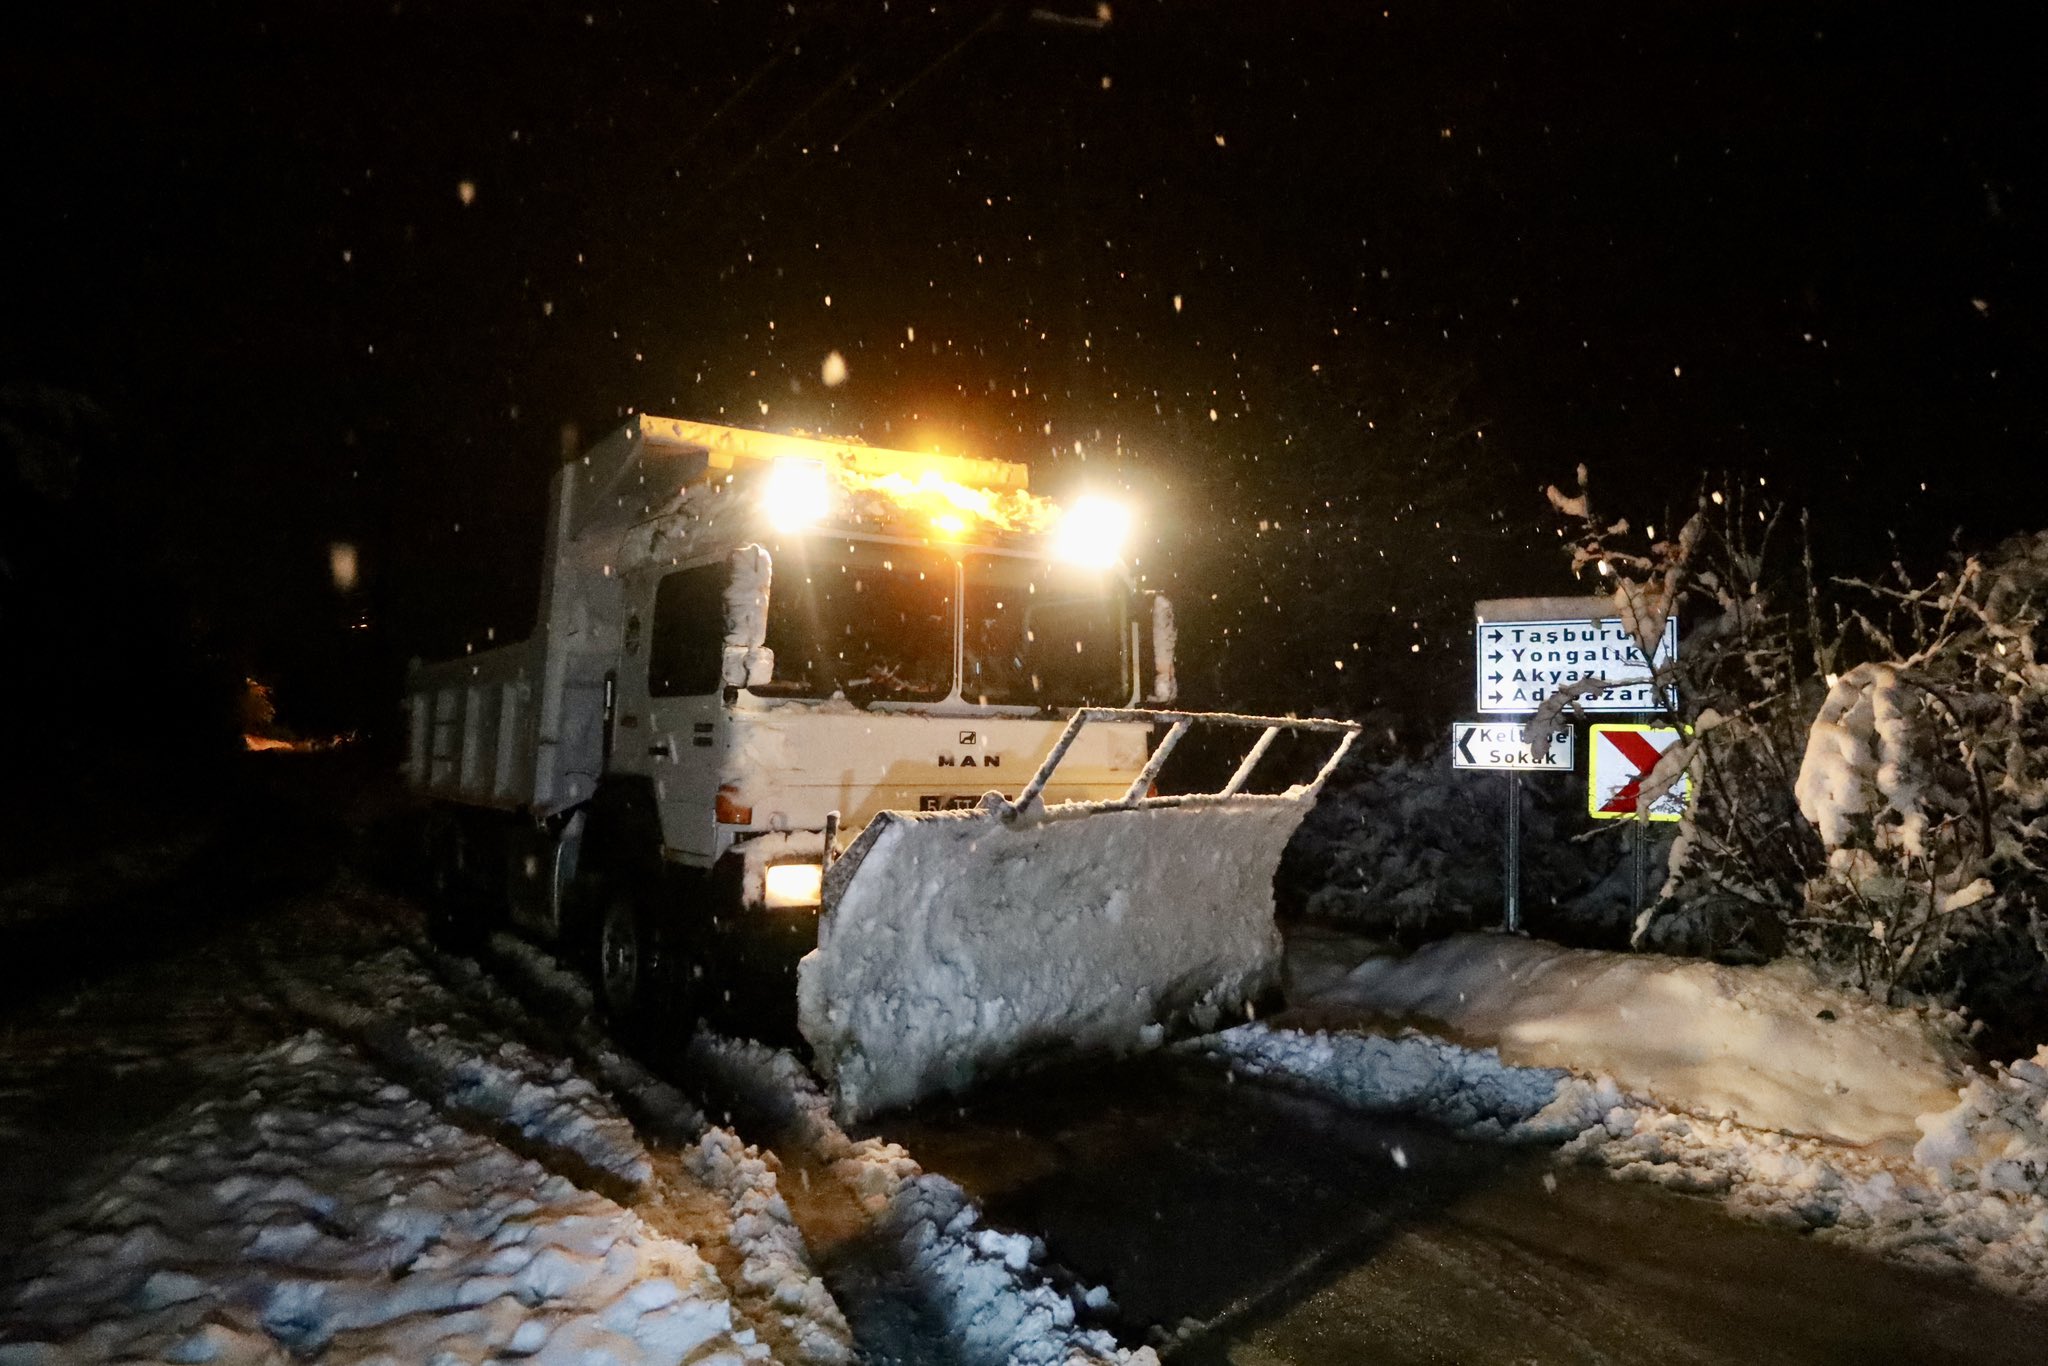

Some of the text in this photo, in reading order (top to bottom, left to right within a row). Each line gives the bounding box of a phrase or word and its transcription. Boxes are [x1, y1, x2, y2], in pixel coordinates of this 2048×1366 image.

[1511, 628, 1640, 644] Taşburu
[1511, 646, 1639, 665] Yongalık
[1512, 668, 1606, 684] Akyazı
[1512, 687, 1655, 702] Adazar
[1480, 728, 1567, 743] Kelte
[938, 755, 1000, 767] MAN
